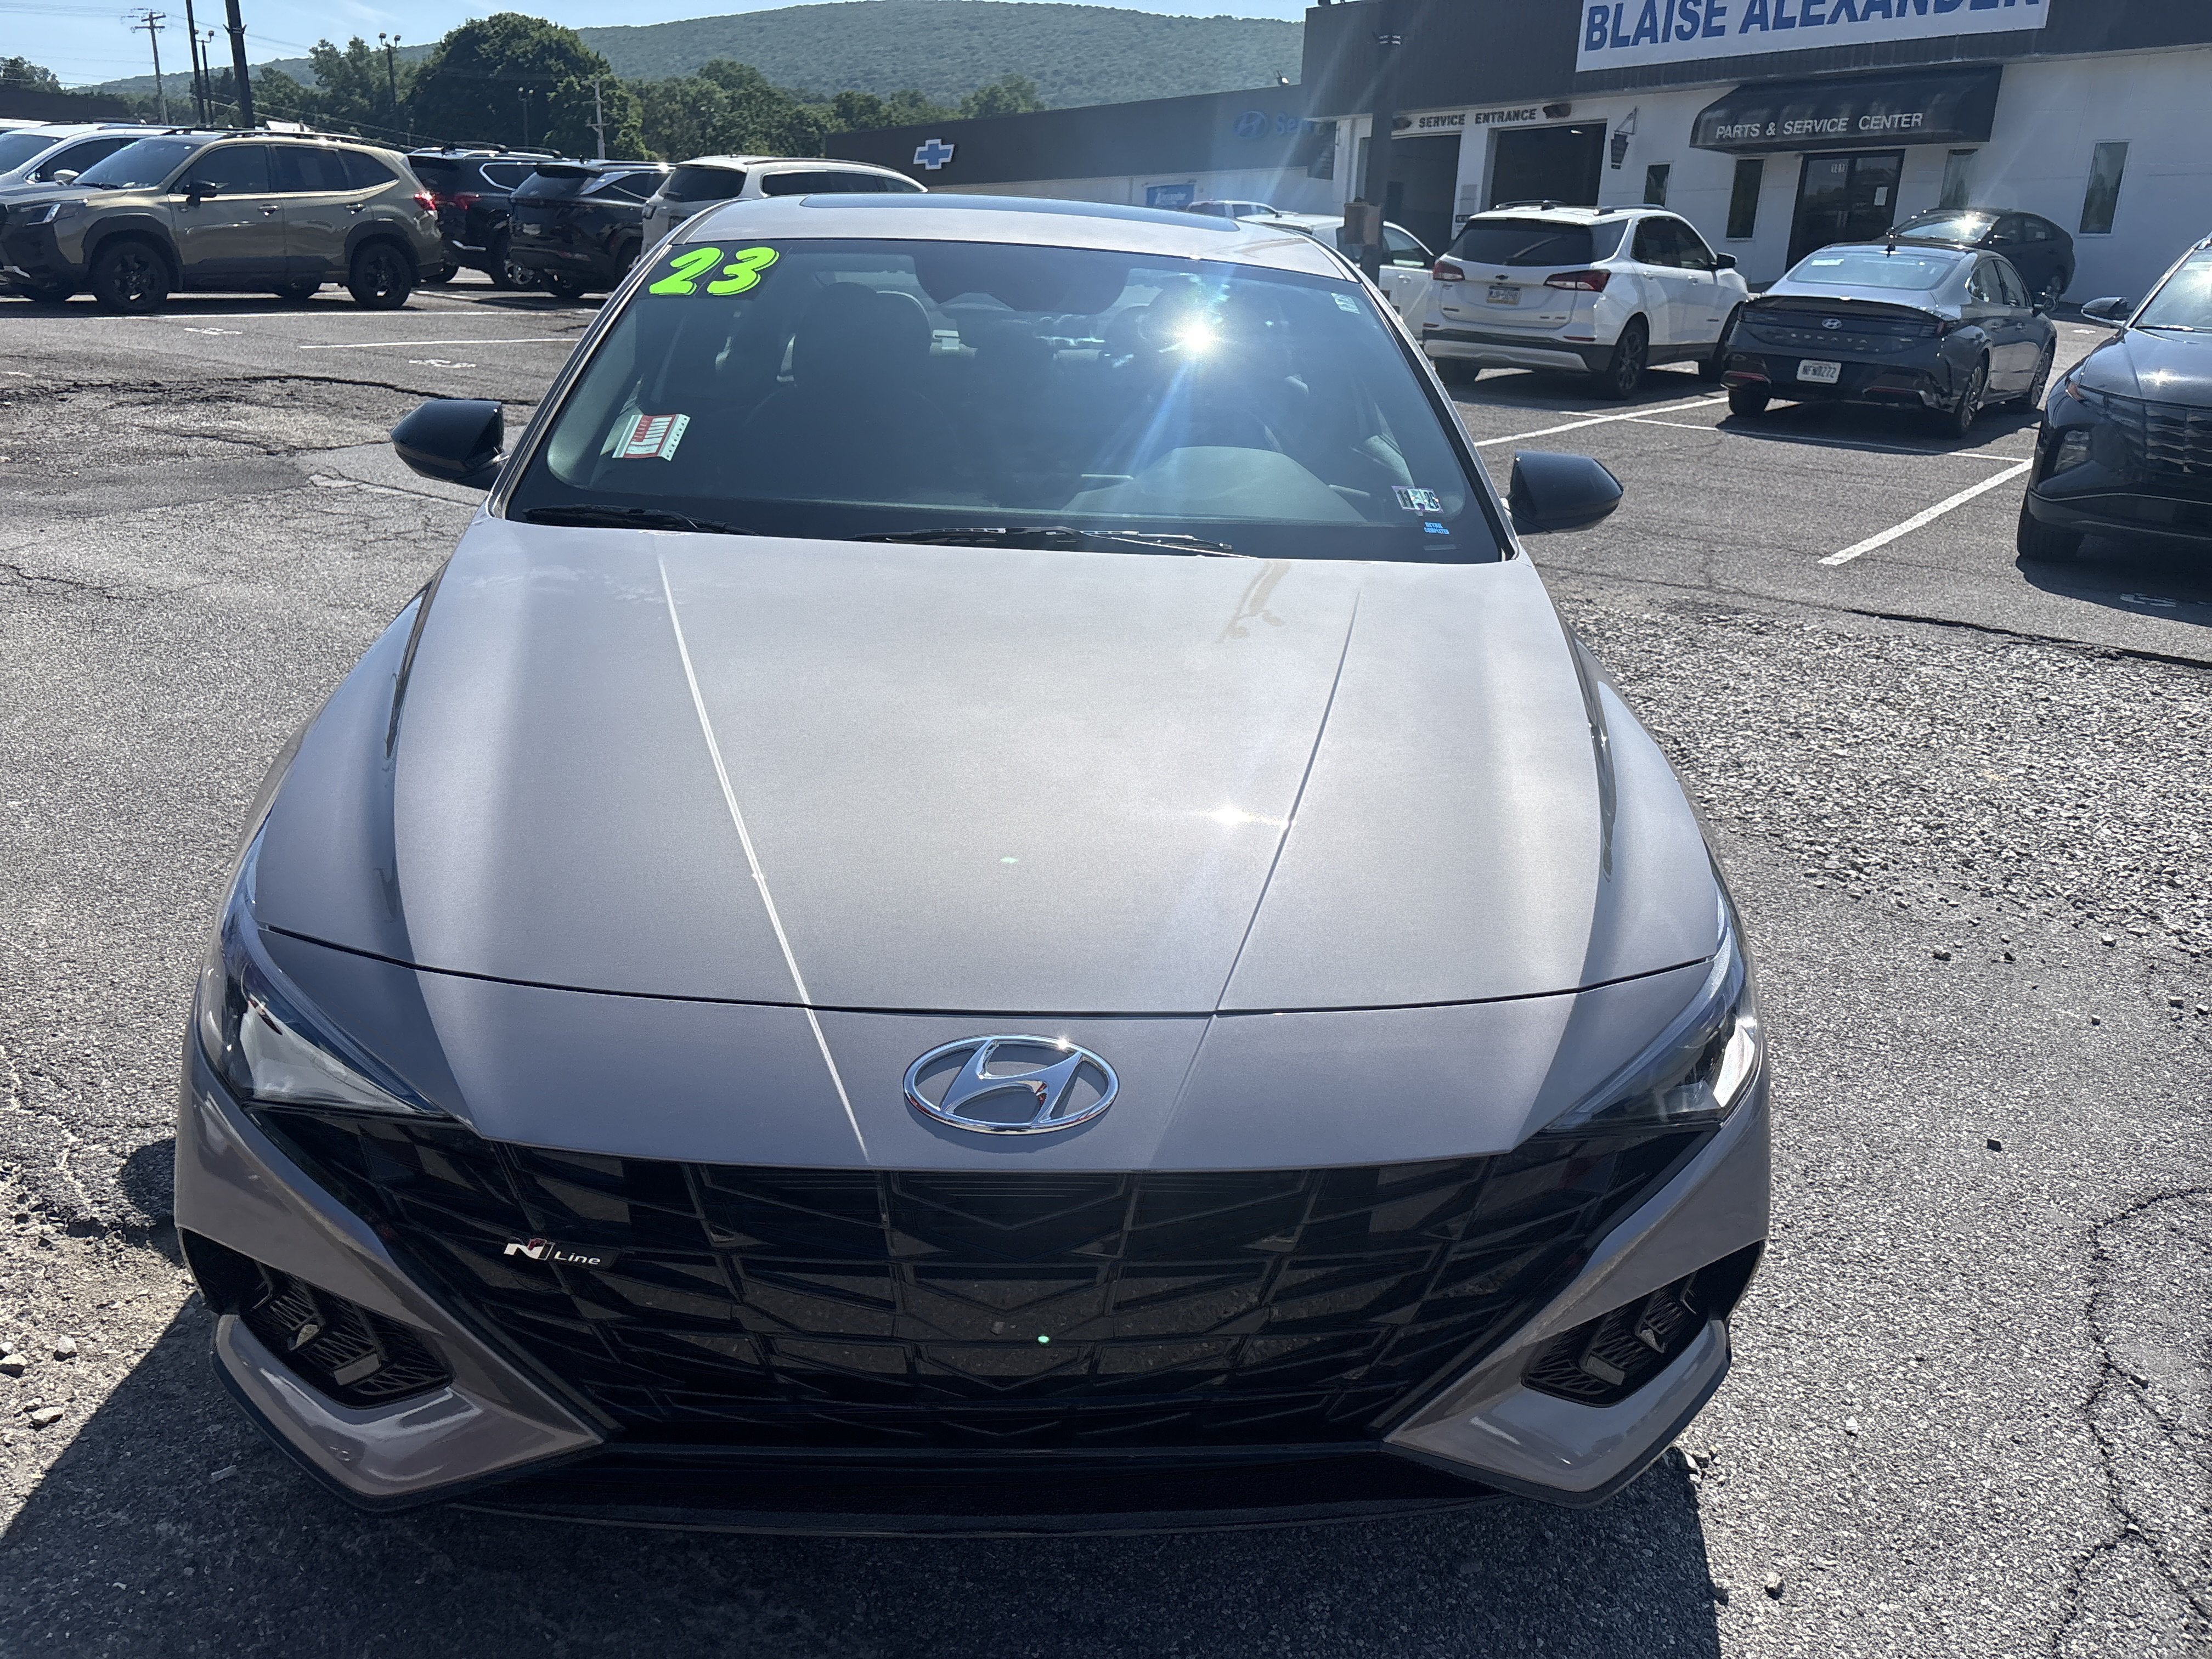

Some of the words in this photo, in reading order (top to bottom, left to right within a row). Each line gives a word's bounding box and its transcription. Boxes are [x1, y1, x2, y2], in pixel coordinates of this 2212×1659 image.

[1585, 0, 1727, 51] BLAISE
[1739, 0, 2040, 34] ALEXA
[1419, 114, 1465, 128] SERVICE
[1475, 109, 1537, 124] ENTRANCE
[1716, 122, 1760, 139] PARTS
[1766, 122, 1776, 136] &
[1783, 117, 1849, 135] SERVICE
[1858, 112, 1923, 130] CENTER
[649, 247, 780, 296] 23
[1397, 490, 1415, 509] 11
[554, 1250, 601, 1265] Line
